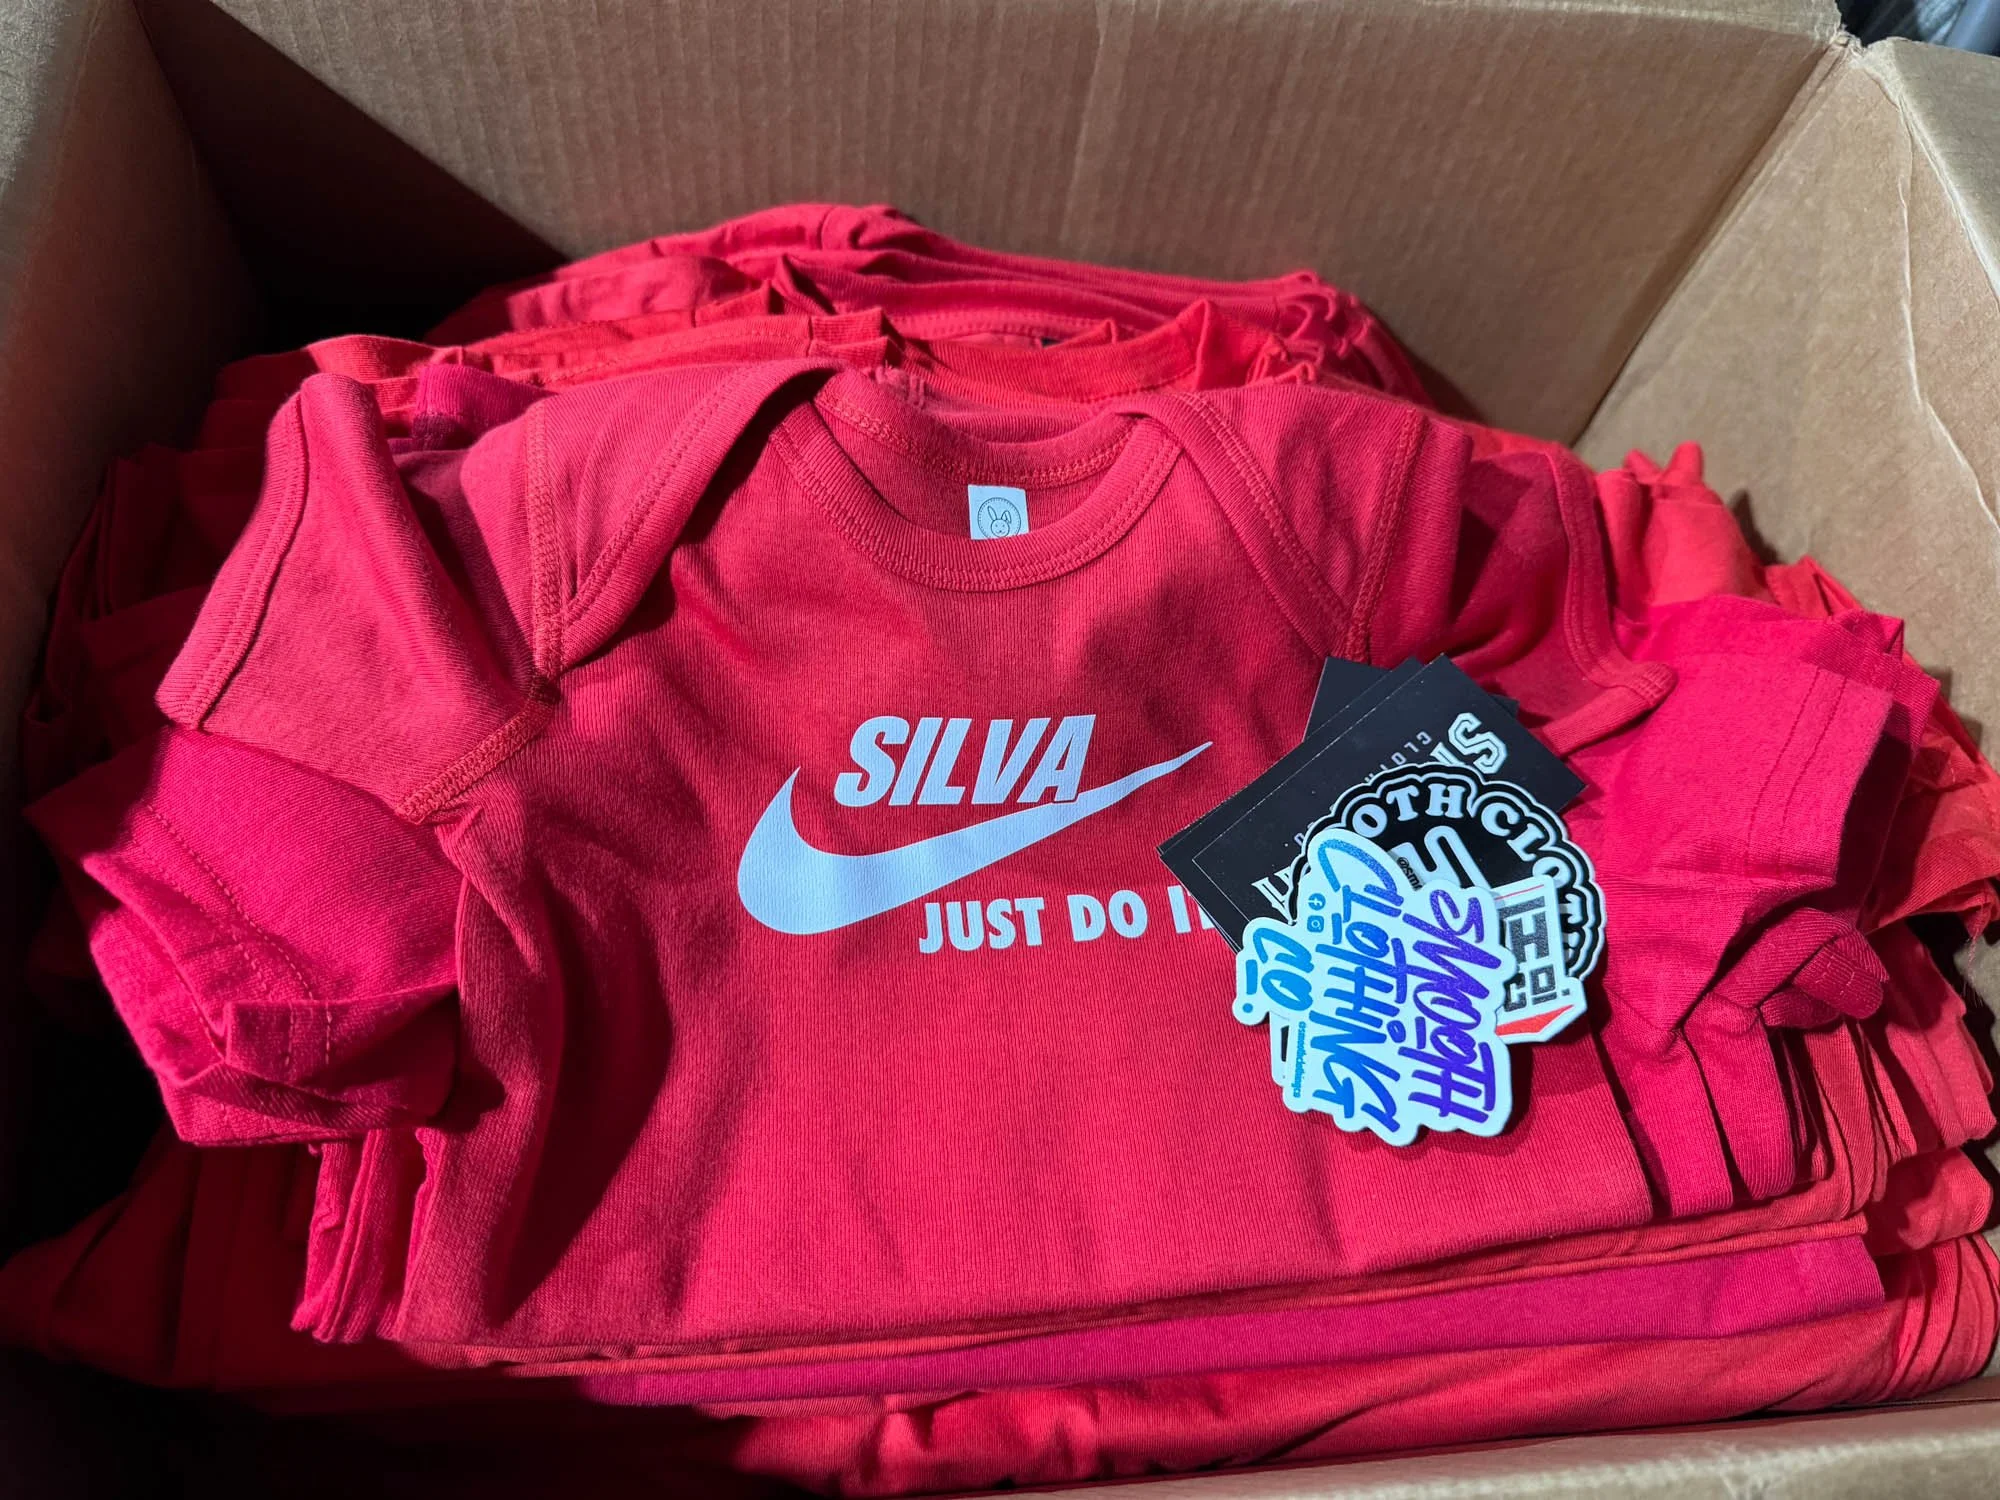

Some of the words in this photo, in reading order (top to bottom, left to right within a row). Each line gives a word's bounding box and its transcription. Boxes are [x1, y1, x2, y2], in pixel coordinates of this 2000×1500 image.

[834, 714, 1096, 807] SILVA
[919, 897, 1044, 954] JUST
[1067, 889, 1148, 942] DO
[1308, 839, 1408, 1132] CLOTHING
[1400, 889, 1502, 1123] SMOOTH
